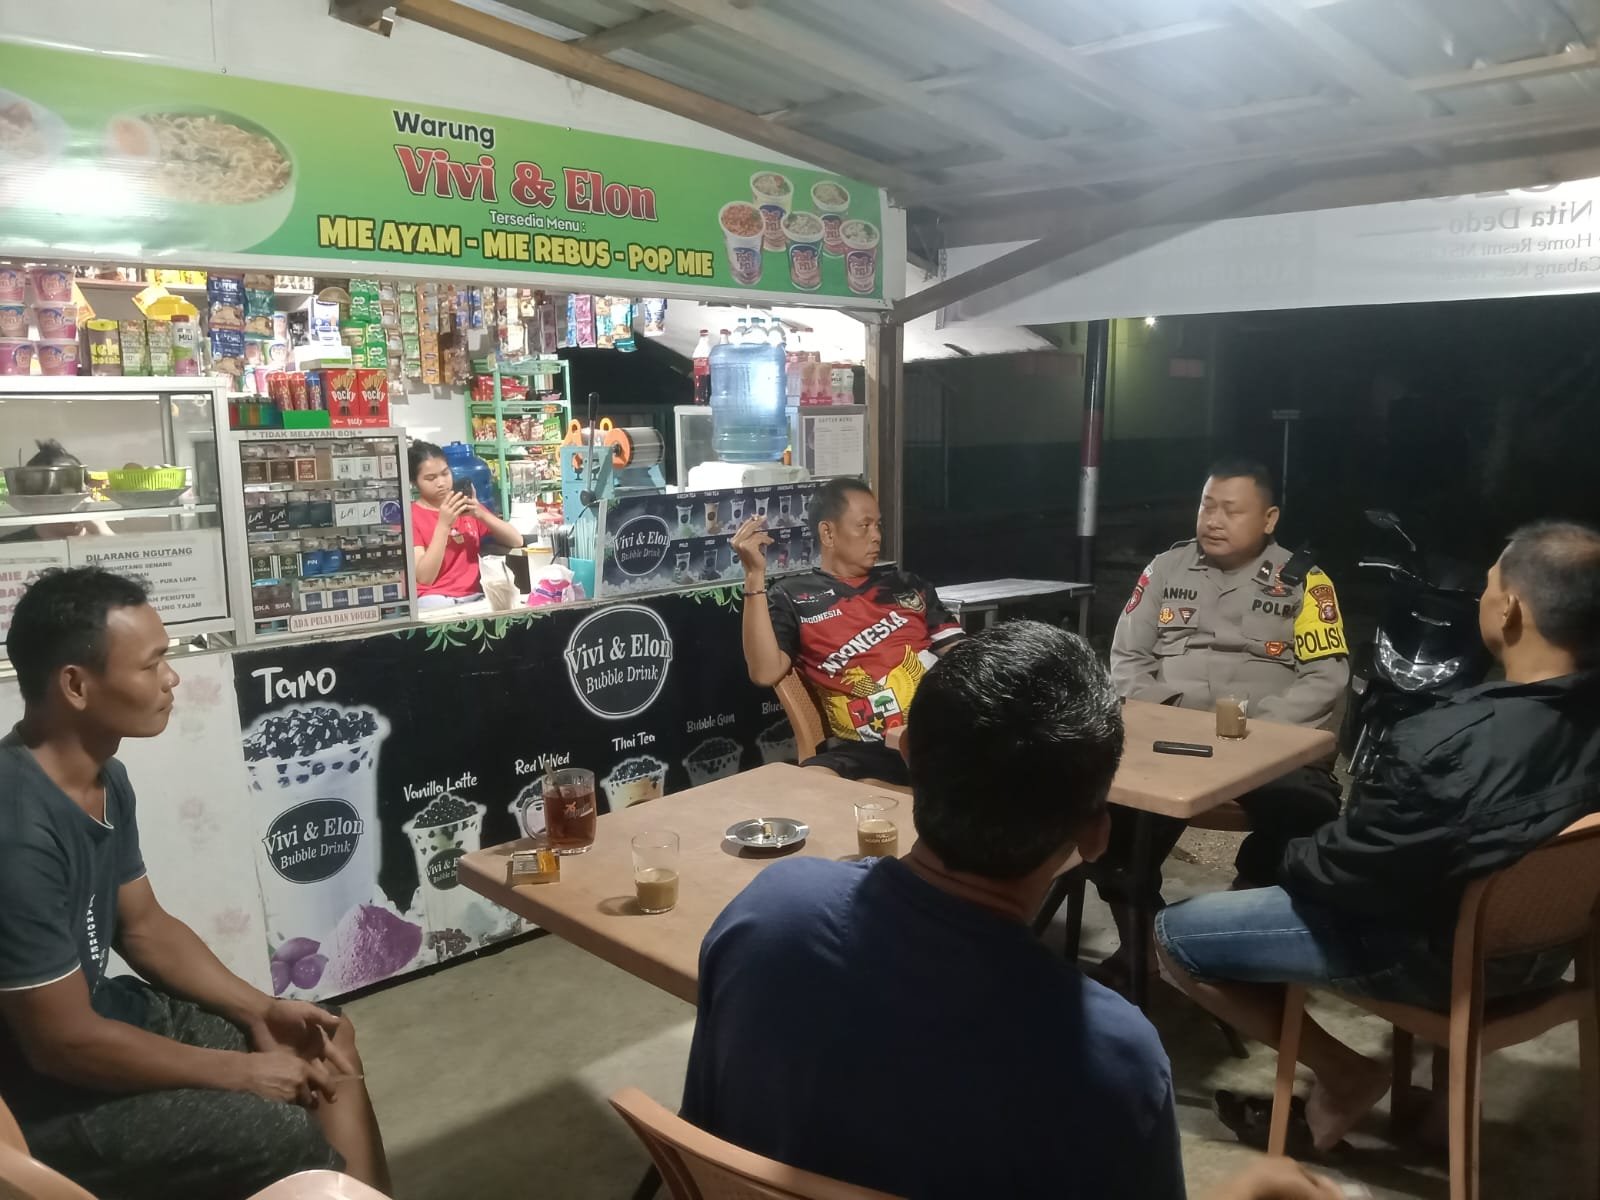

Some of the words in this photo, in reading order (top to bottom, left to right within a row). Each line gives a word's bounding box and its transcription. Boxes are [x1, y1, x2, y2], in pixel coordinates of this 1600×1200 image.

[393, 111, 495, 149] Warung
[394, 144, 498, 202] Vivi
[510, 161, 556, 208] &
[563, 168, 658, 221] Elon
[490, 211, 544, 229] Tersedia
[546, 216, 580, 232] Menu
[318, 215, 375, 250] MIE
[379, 220, 461, 258] AYAM
[482, 229, 530, 261] MIE
[533, 233, 610, 268] REBUS
[628, 243, 673, 272] POP
[676, 249, 714, 278] MIE
[331, 390, 356, 402] POCKY
[361, 390, 386, 403] POCKY
[341, 508, 354, 519] LA
[364, 506, 376, 518] LA
[614, 533, 634, 551] Vivi
[636, 533, 645, 545] &
[86, 552, 139, 562] DILARANG
[143, 547, 192, 558] NGUTANG
[1163, 587, 1198, 601] ANHU
[293, 618, 309, 630] ADA
[310, 615, 332, 627] PULSA
[334, 613, 350, 625] DAN
[350, 610, 377, 623] VOUCER
[800, 609, 842, 624] INDONESIA
[1296, 627, 1344, 655] POLISI
[567, 646, 603, 674] Vivi
[609, 636, 626, 659] &
[630, 633, 672, 659] Elon
[252, 667, 336, 704] Taro
[585, 670, 623, 695] Bubble
[627, 665, 659, 683] Drink
[687, 717, 715, 734] Bubble
[612, 735, 635, 752] Thai
[637, 731, 656, 745] Tea
[515, 759, 536, 775] Red
[403, 782, 444, 802] Vanilla
[446, 772, 478, 792] Latte
[263, 830, 298, 856] Vivi
[303, 822, 319, 842] &
[324, 818, 364, 837] Elon
[280, 844, 317, 870] Bubble
[320, 839, 351, 857] Drink
[426, 863, 442, 877] Vivi
[443, 861, 452, 869] &
